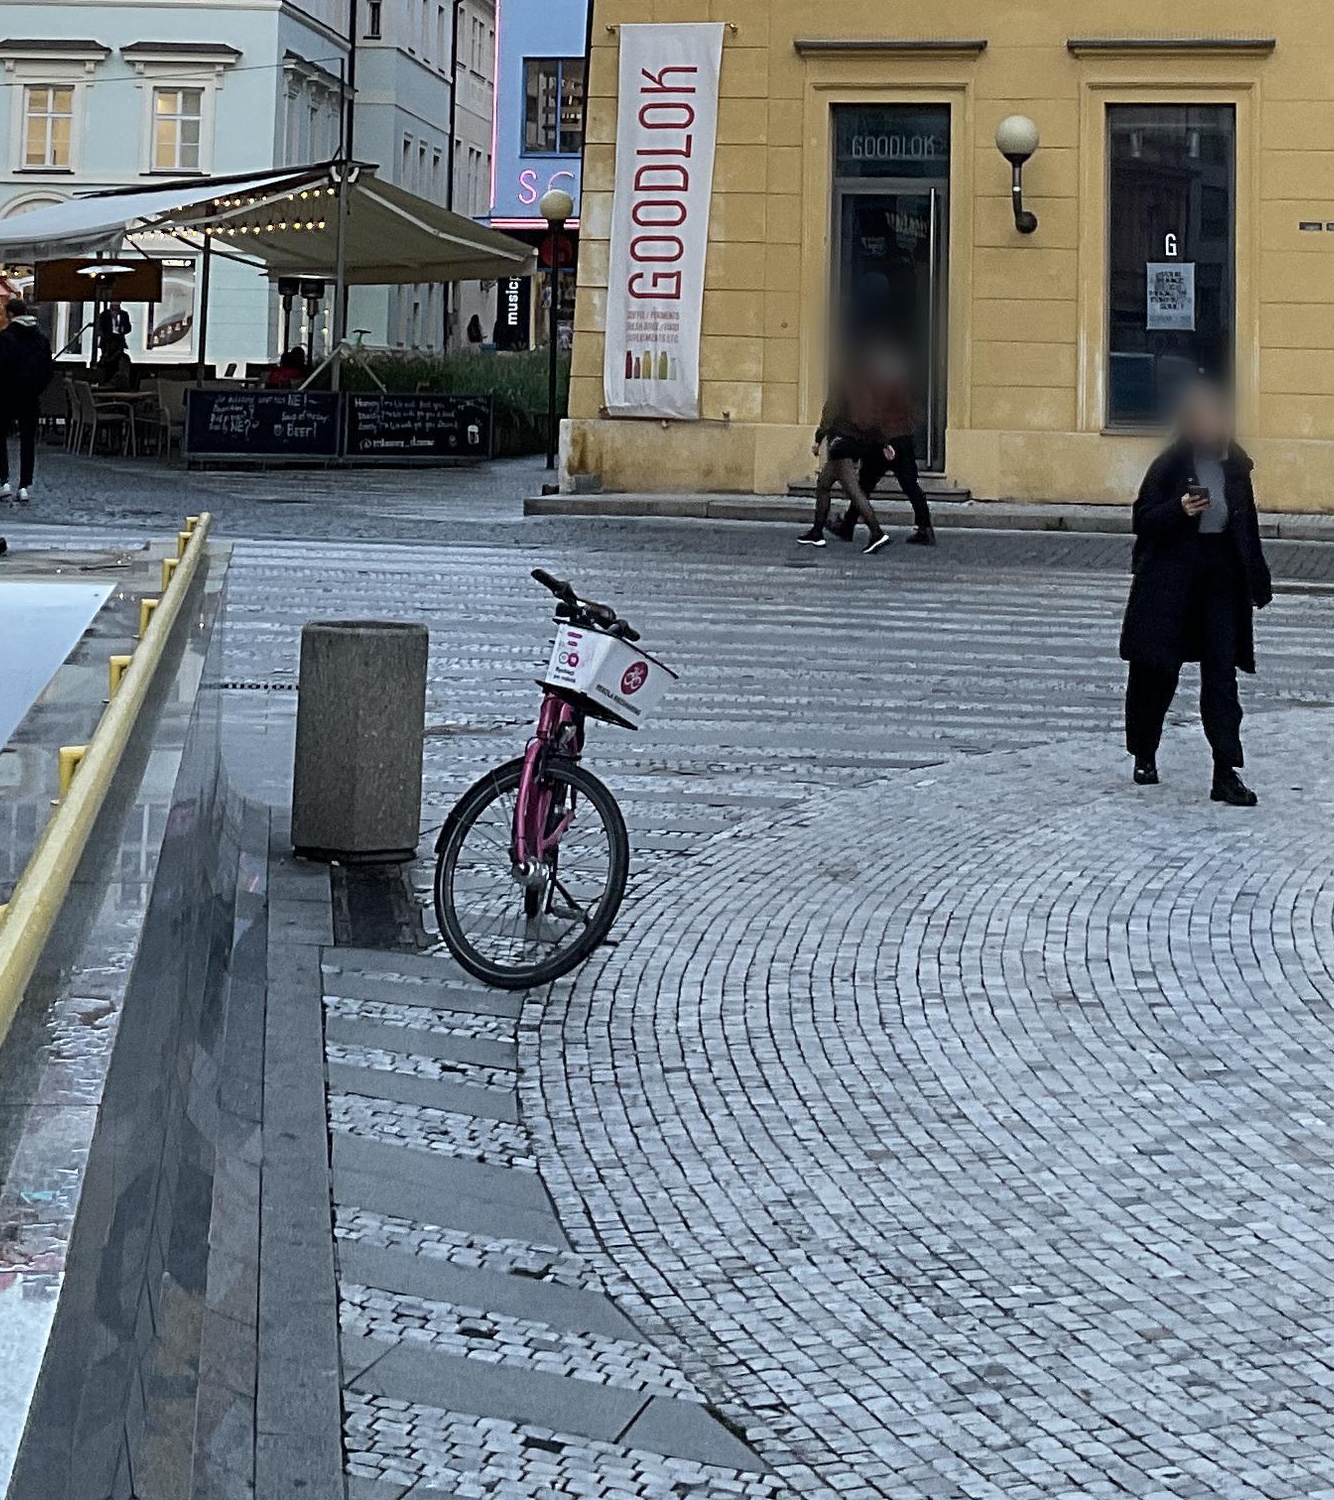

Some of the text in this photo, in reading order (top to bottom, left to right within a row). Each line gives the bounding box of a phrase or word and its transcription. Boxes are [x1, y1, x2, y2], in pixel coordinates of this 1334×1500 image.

[851, 134, 937, 159] GOODLOK
[628, 67, 698, 300] GOODLOK
[1165, 233, 1177, 256] G
